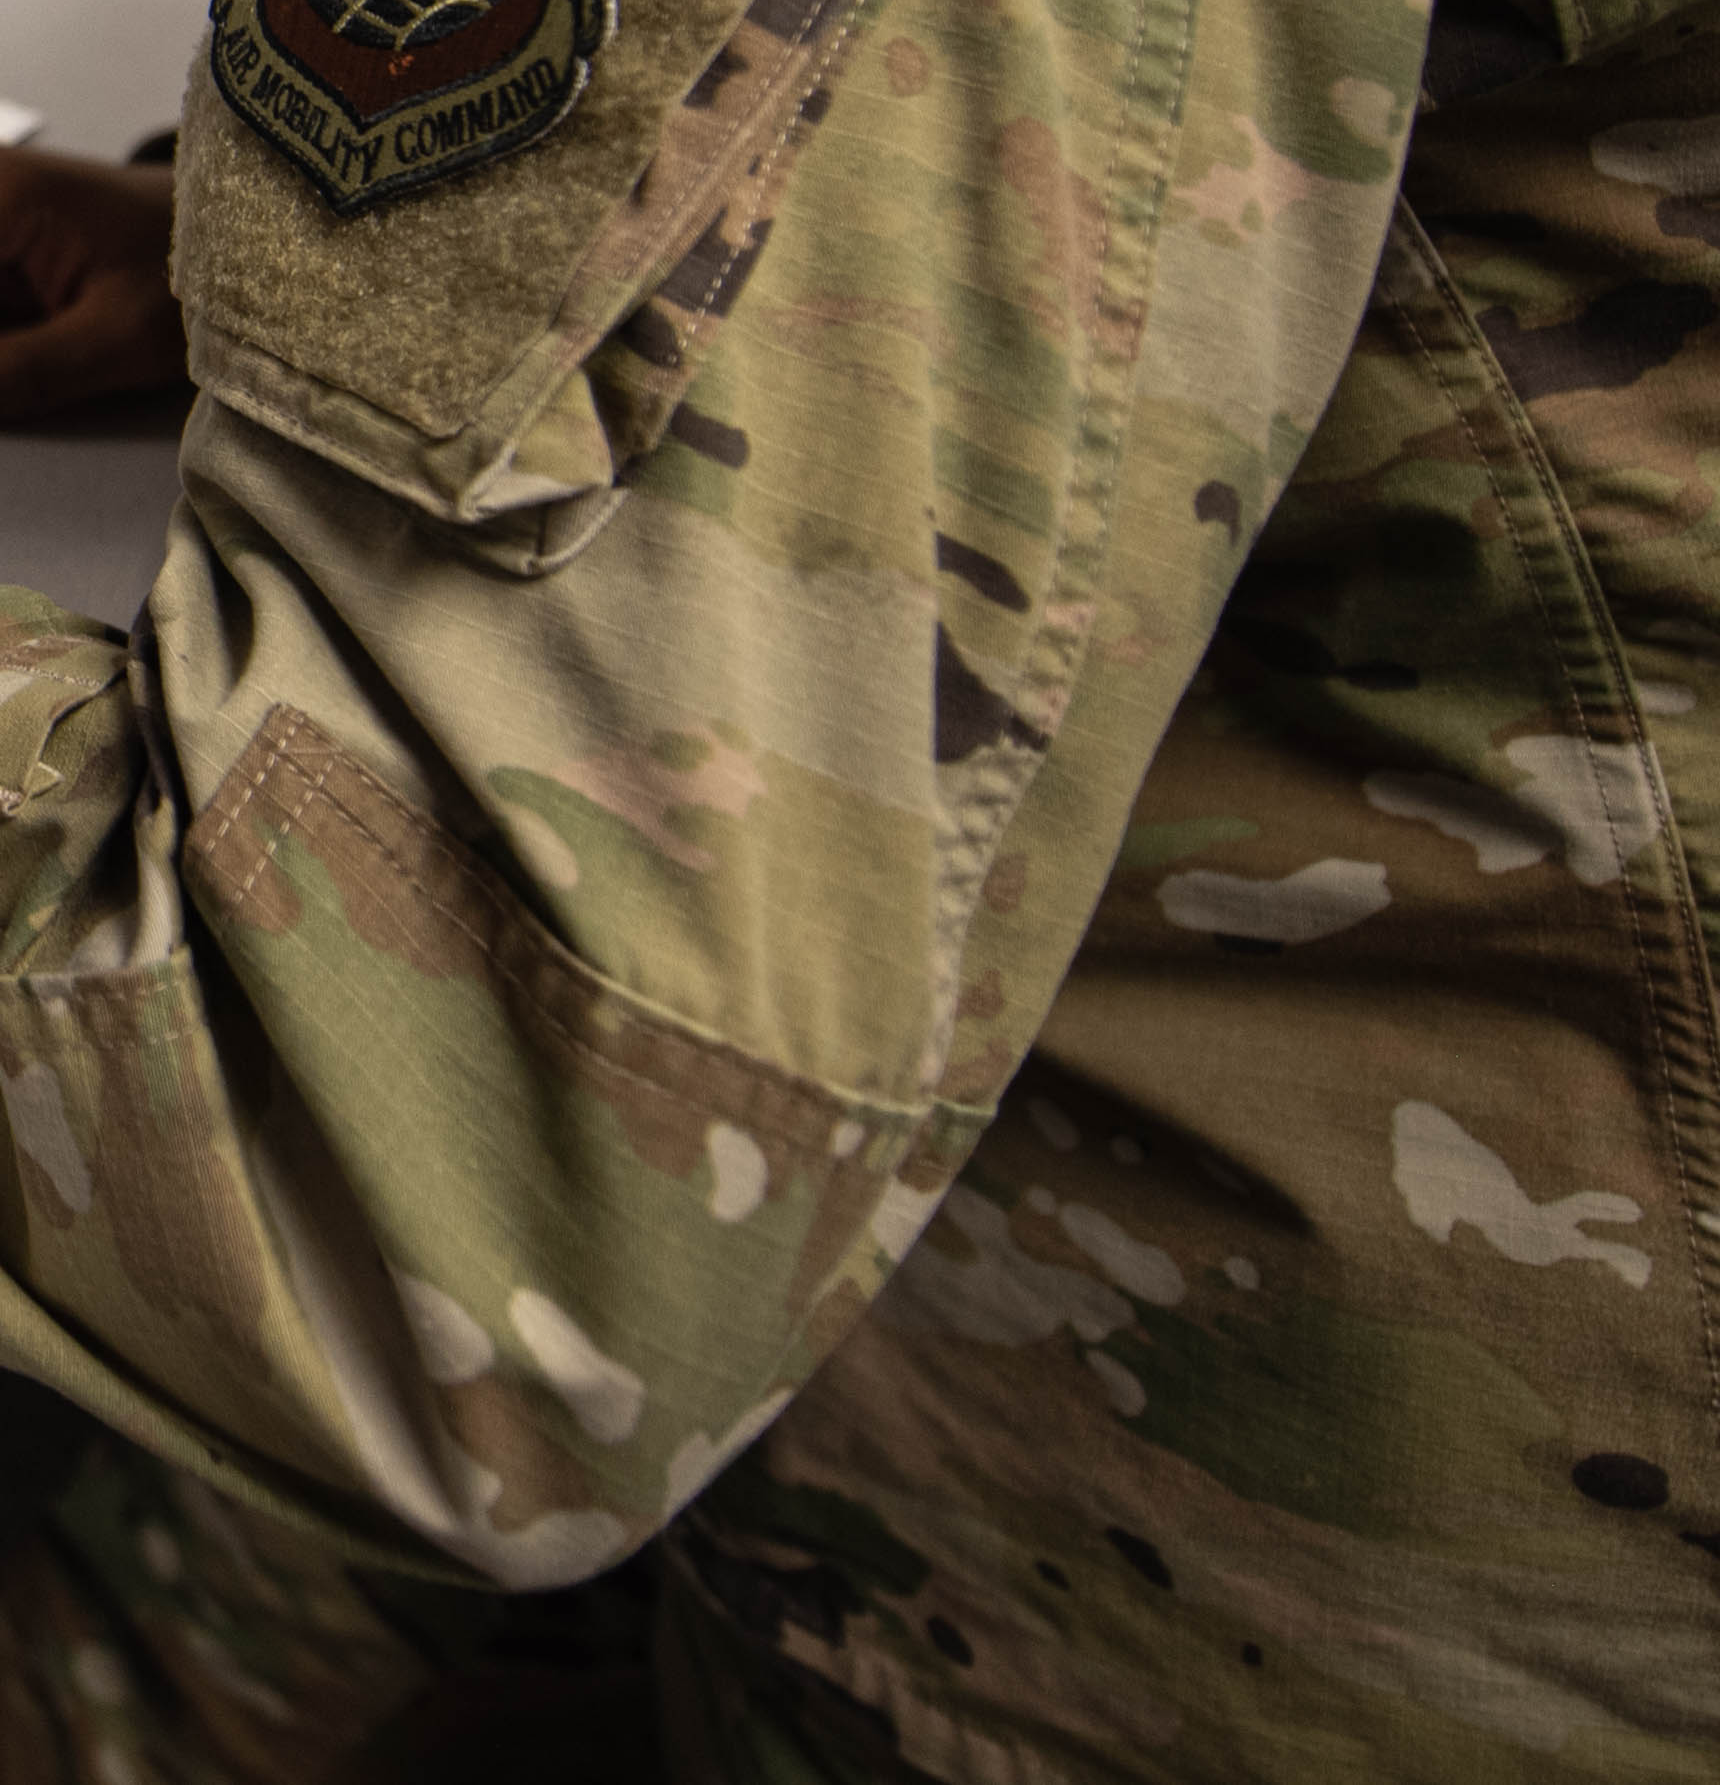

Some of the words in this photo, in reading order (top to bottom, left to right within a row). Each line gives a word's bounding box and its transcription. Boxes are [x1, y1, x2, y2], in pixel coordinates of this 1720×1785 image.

[224, 27, 259, 86] AIR
[250, 64, 384, 184] MOBILITY
[394, 57, 559, 164] COMMAND
